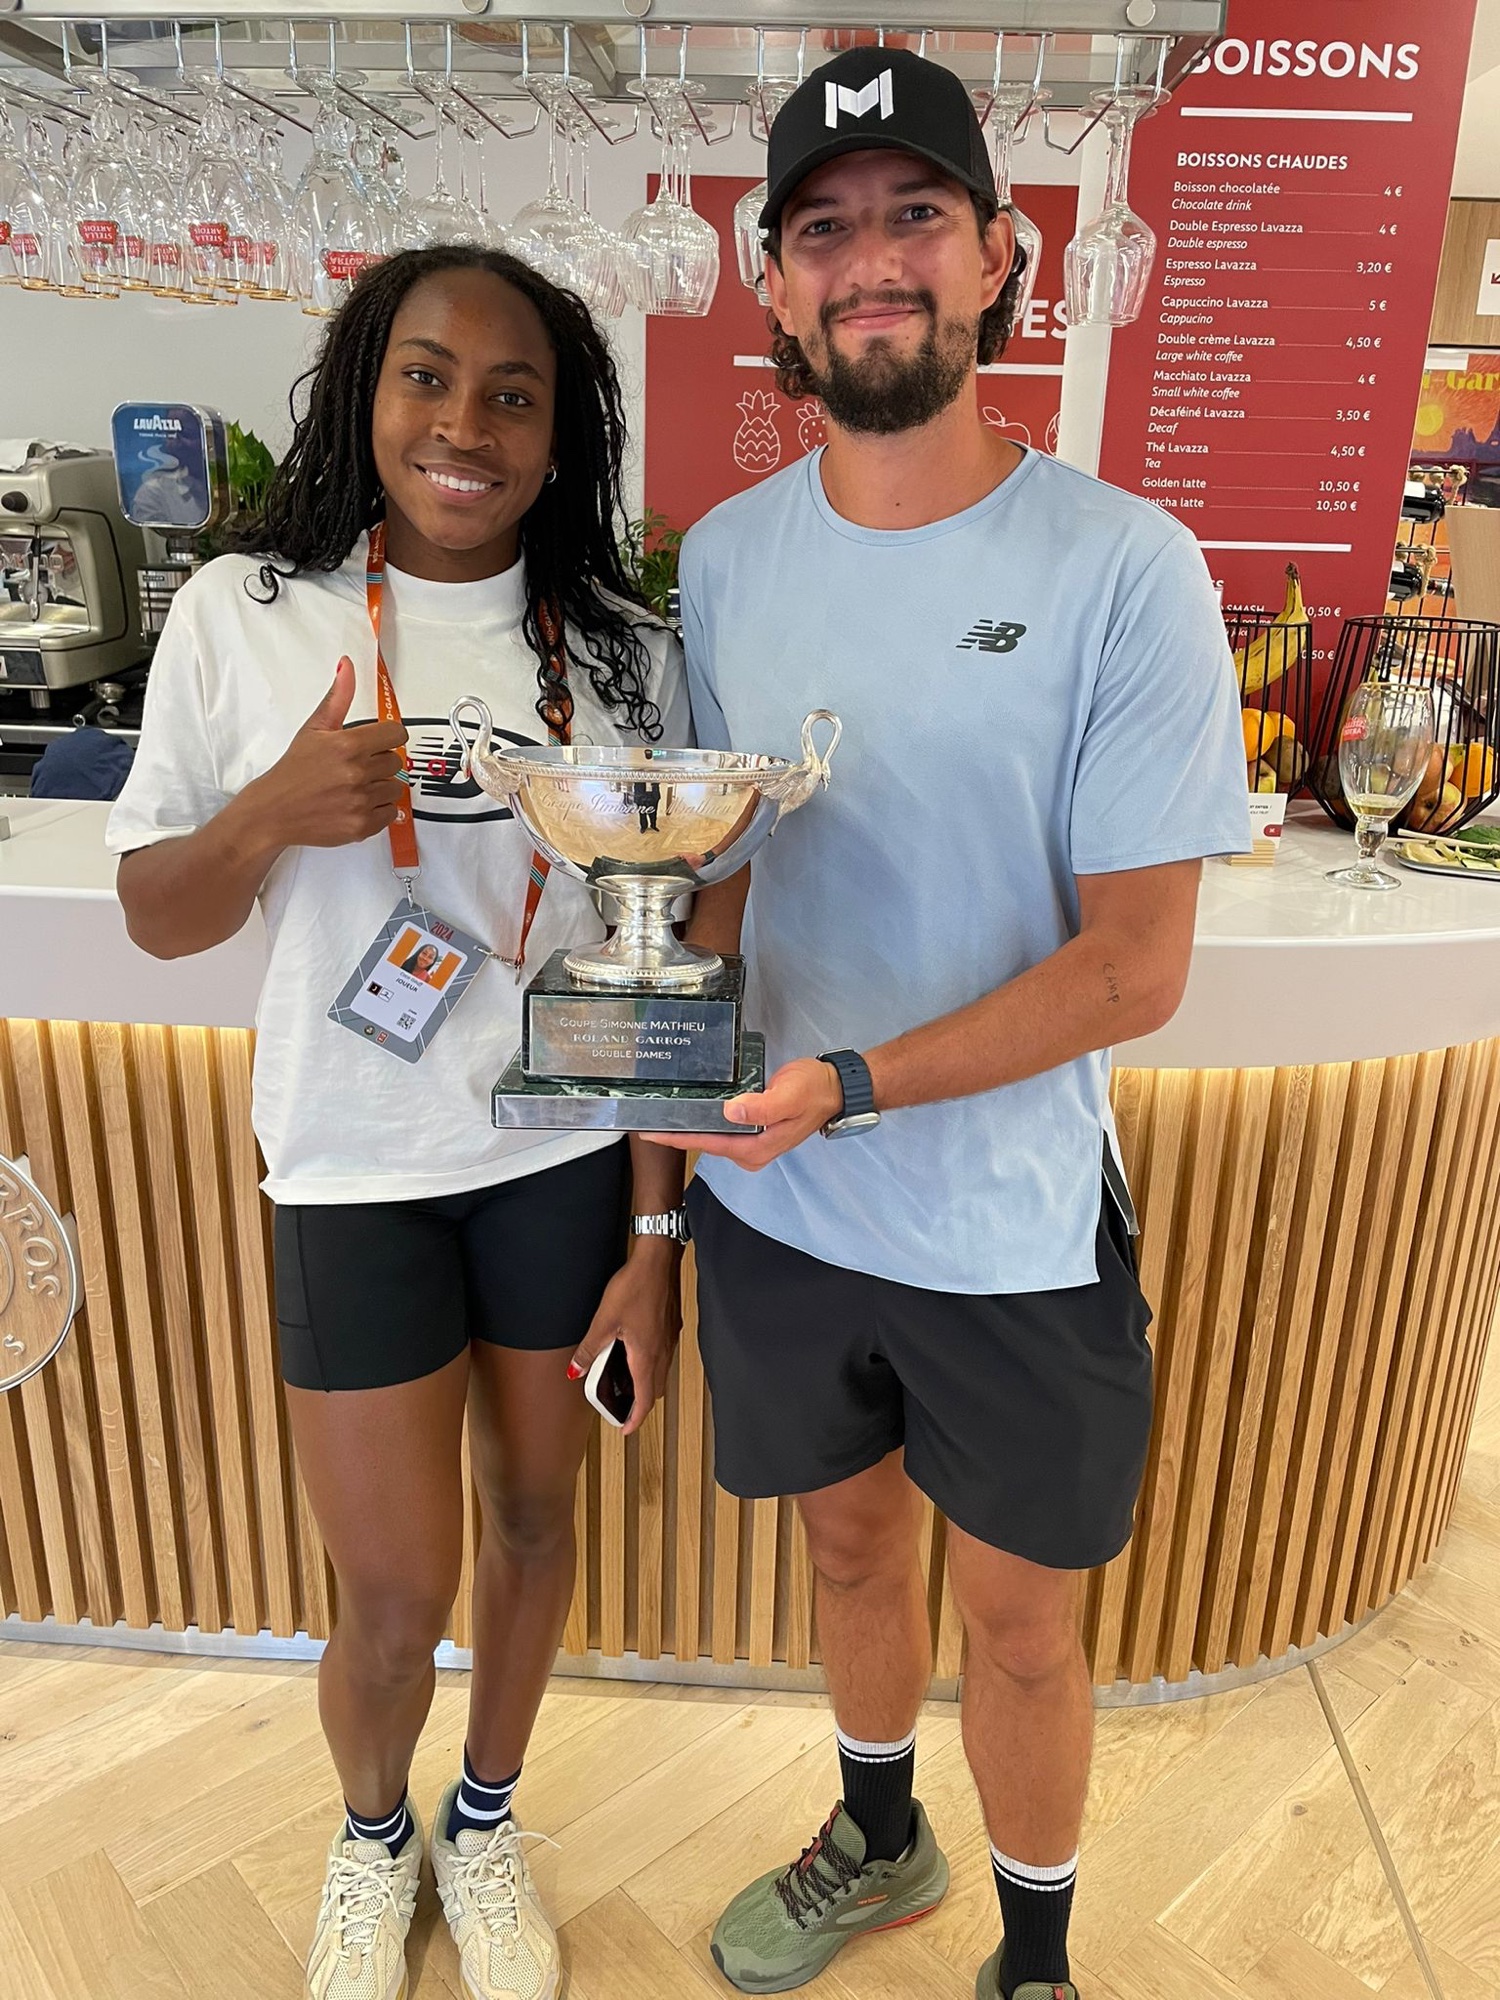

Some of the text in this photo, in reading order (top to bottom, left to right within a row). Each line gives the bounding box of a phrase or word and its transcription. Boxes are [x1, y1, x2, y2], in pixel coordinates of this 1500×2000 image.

[1178, 153, 1347, 170] BOISSONS CHAUDES
[1174, 181, 1280, 193] Boisson chocolatée
[1384, 186, 1402, 196] 4 €
[1172, 199, 1252, 210] Chocolate drink
[1170, 220, 1303, 233] Double Espresso Lavazza
[1379, 224, 1397, 235] 4 €
[1168, 237, 1247, 250] Double espresso
[1166, 258, 1256, 271] Espresso Lavazza
[1357, 262, 1392, 274] 3,20 €
[1164, 275, 1205, 288] Espresso
[1162, 296, 1268, 309] Cappuccino Lavazza
[1369, 300, 1386, 311] 5 €
[1160, 313, 1213, 325] Cappucino
[1158, 333, 1275, 345] Double crème Lavazza
[1346, 337, 1381, 349] 4,50 €
[1156, 350, 1243, 363] Large white coffee
[1154, 370, 1251, 382] Macchiato Lavazza
[1358, 374, 1376, 384] 4 €
[1152, 387, 1239, 399] Small white coffee
[1150, 406, 1244, 418] Décaféiné Lavazza
[1336, 410, 1370, 422] 3,50 €
[134, 414, 182, 431] LAVAZZA
[1148, 423, 1178, 435] Decaf
[1146, 442, 1208, 453] Thé Lavazza
[1331, 446, 1365, 457] 4,50 €
[1145, 458, 1161, 468] Tea
[1142, 478, 1206, 488] Golden latte
[1319, 481, 1359, 492] 10,50 €
[1146, 497, 1204, 507] atcha latte
[1316, 501, 1357, 512] 10,50 €
[1303, 606, 1341, 618] 0,50 €
[1327, 650, 1335, 660] €
[430, 921, 454, 941] 2024
[650, 1021, 705, 1032] MATHIEU
[573, 1034, 692, 1046] ROLAND GARROS
[592, 1050, 672, 1060] DOUBLE DAMES
